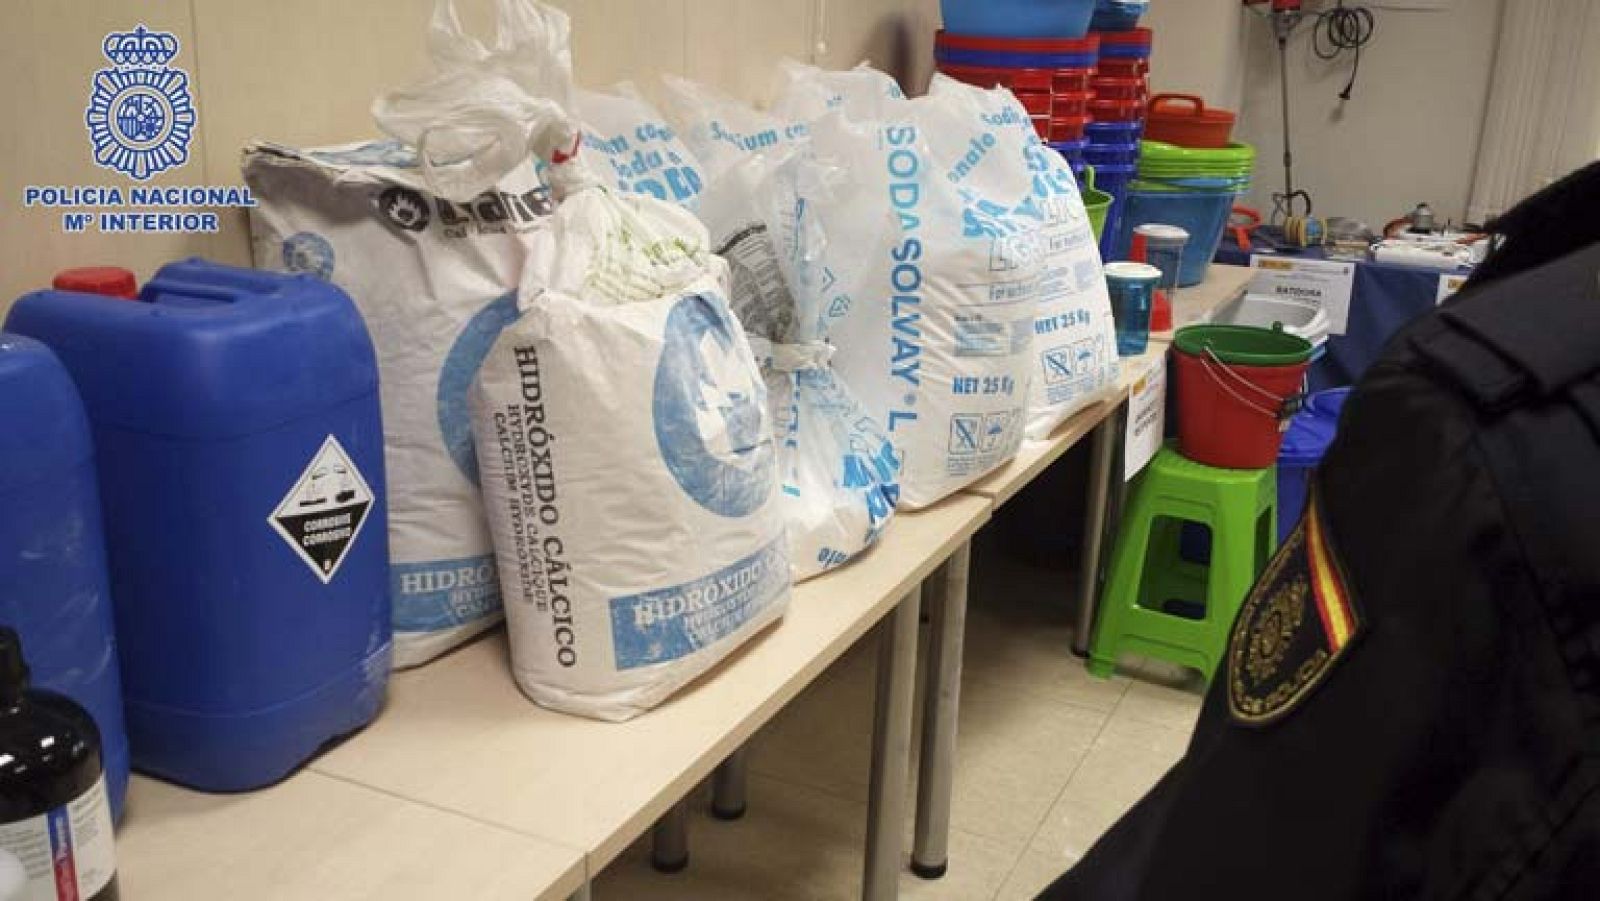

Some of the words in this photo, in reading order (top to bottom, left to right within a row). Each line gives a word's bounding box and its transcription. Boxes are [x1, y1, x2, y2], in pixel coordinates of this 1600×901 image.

[886, 126, 921, 231] SODA
[891, 238, 923, 388] SOLVAY
[953, 376, 978, 394] NET
[983, 376, 999, 395] 25
[514, 346, 559, 526] HIDRÓXIDO
[543, 535, 577, 668] CÁLCICO
